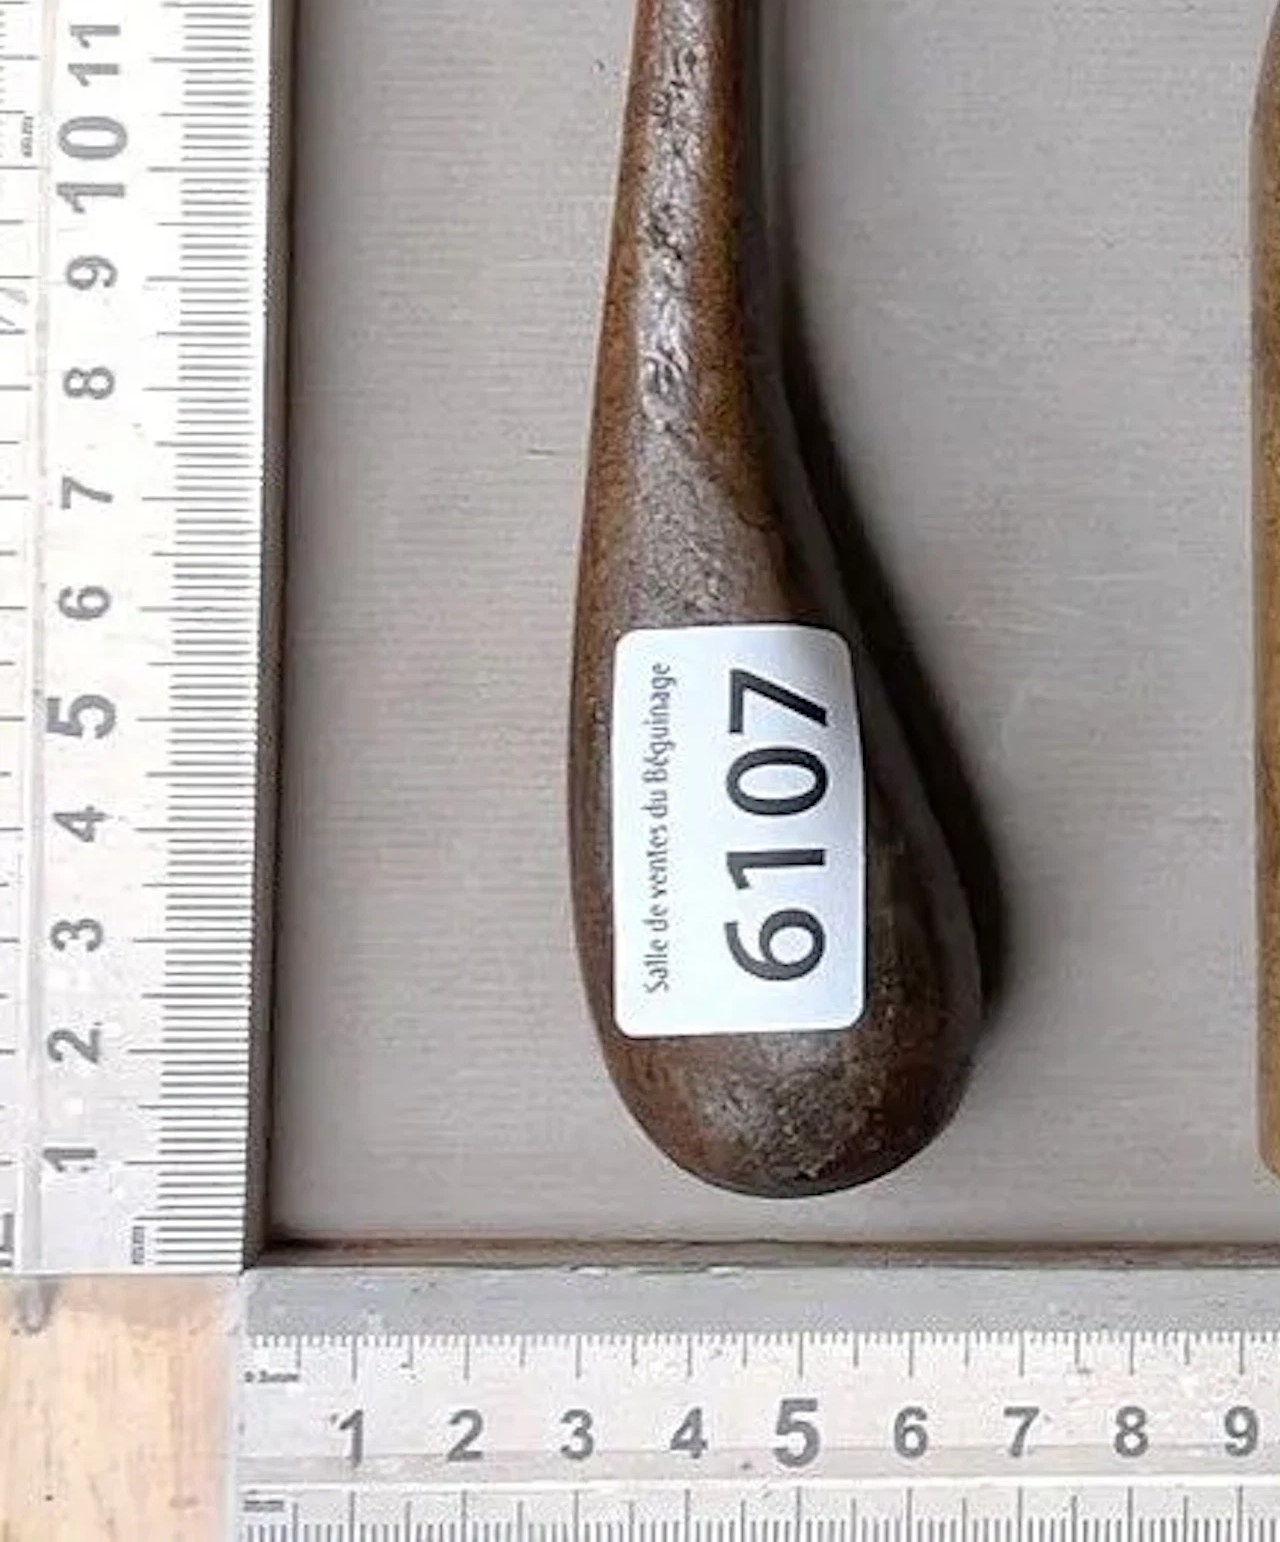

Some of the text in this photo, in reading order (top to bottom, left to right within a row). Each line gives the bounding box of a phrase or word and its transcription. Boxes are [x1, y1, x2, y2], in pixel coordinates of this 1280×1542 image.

[67, 23, 121, 86] 11
[56, 116, 128, 214] 10
[65, 255, 118, 290] 9
[63, 367, 116, 400] 8
[61, 476, 114, 509] 7
[58, 585, 111, 620] 6
[46, 694, 117, 739] 5
[53, 806, 107, 842] 4
[640, 662, 677, 994] Salle de ventes du Béguinage
[724, 668, 829, 982] 6107
[50, 918, 103, 951] 3
[47, 1027, 101, 1064] 2
[43, 1147, 97, 1172] 1
[338, 1409, 364, 1465] 1
[447, 1409, 484, 1459] 2
[560, 1409, 595, 1460] 3
[670, 1408, 708, 1459] 4
[773, 1399, 820, 1467] 5
[893, 1406, 929, 1458] 6
[1003, 1406, 1040, 1457] 7
[1114, 1406, 1149, 1457] 8
[1223, 1406, 1259, 1457] 9
